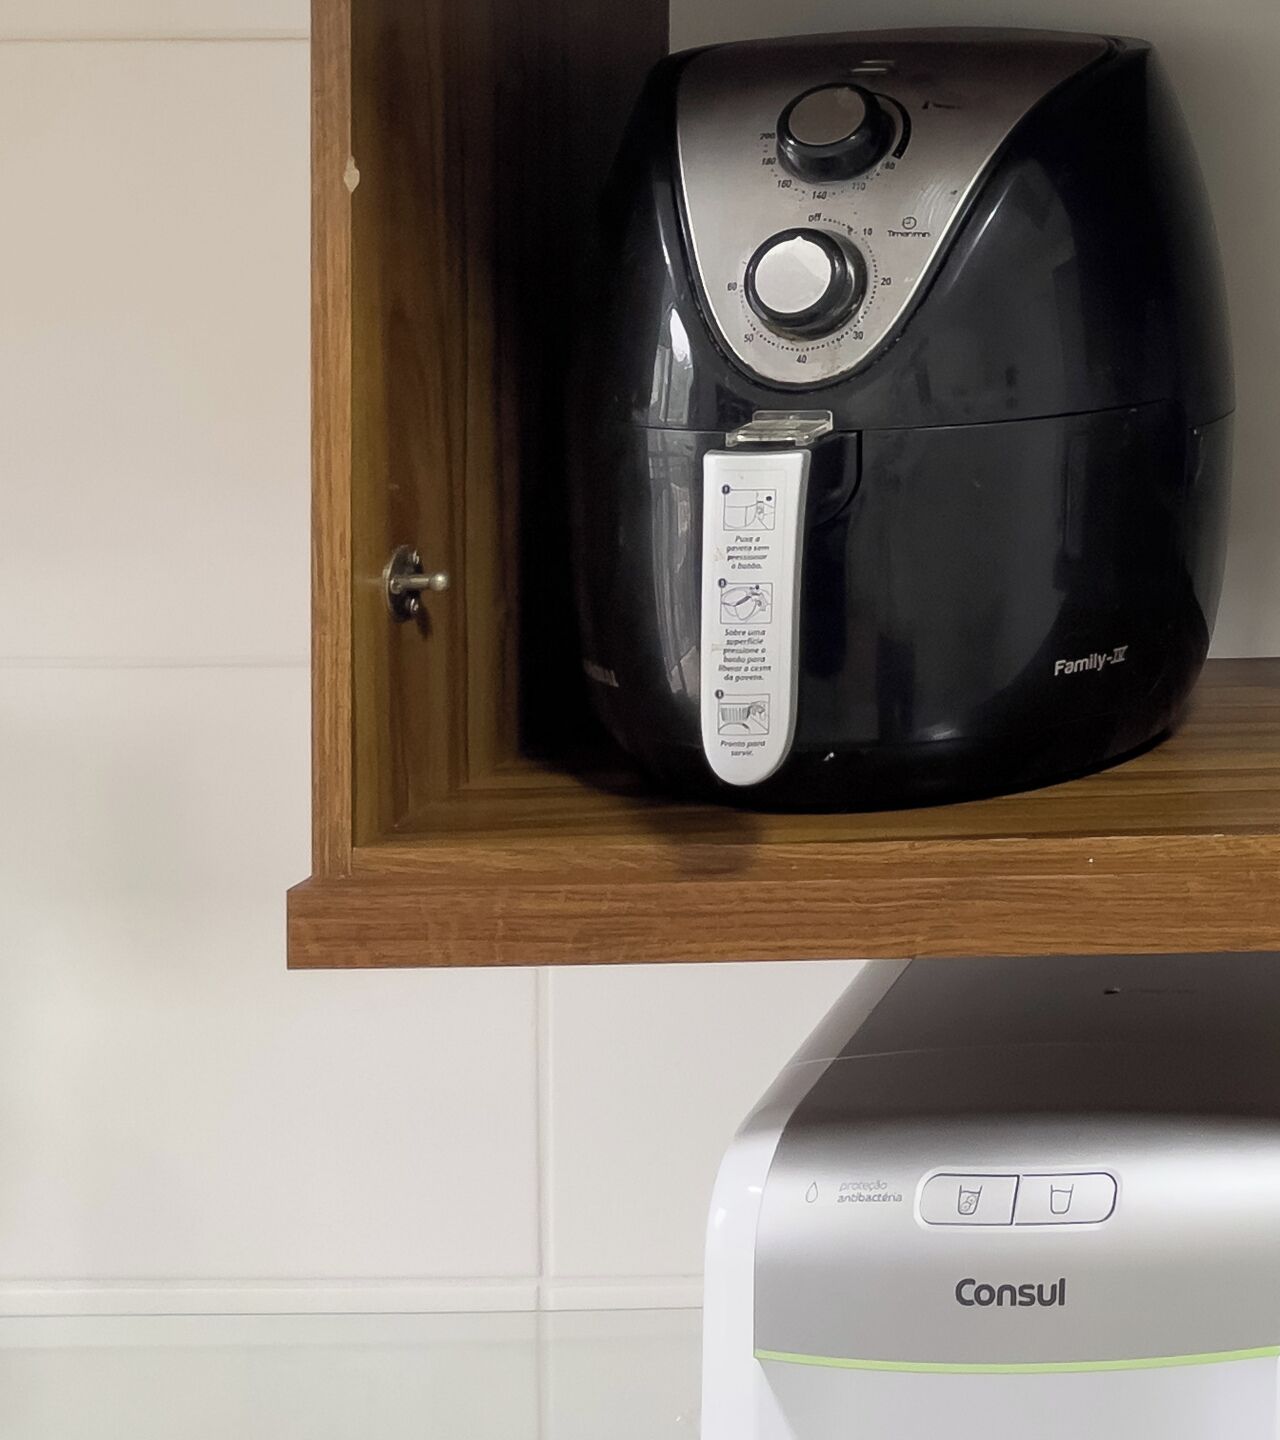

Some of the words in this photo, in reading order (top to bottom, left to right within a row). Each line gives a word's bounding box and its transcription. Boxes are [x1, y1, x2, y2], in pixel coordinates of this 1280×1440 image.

[863, 227, 873, 236] 10
[880, 277, 891, 285] 20
[743, 333, 754, 343] 50
[852, 330, 864, 340] 30
[796, 355, 808, 364] 40
[955, 1278, 1066, 1307] Consul
